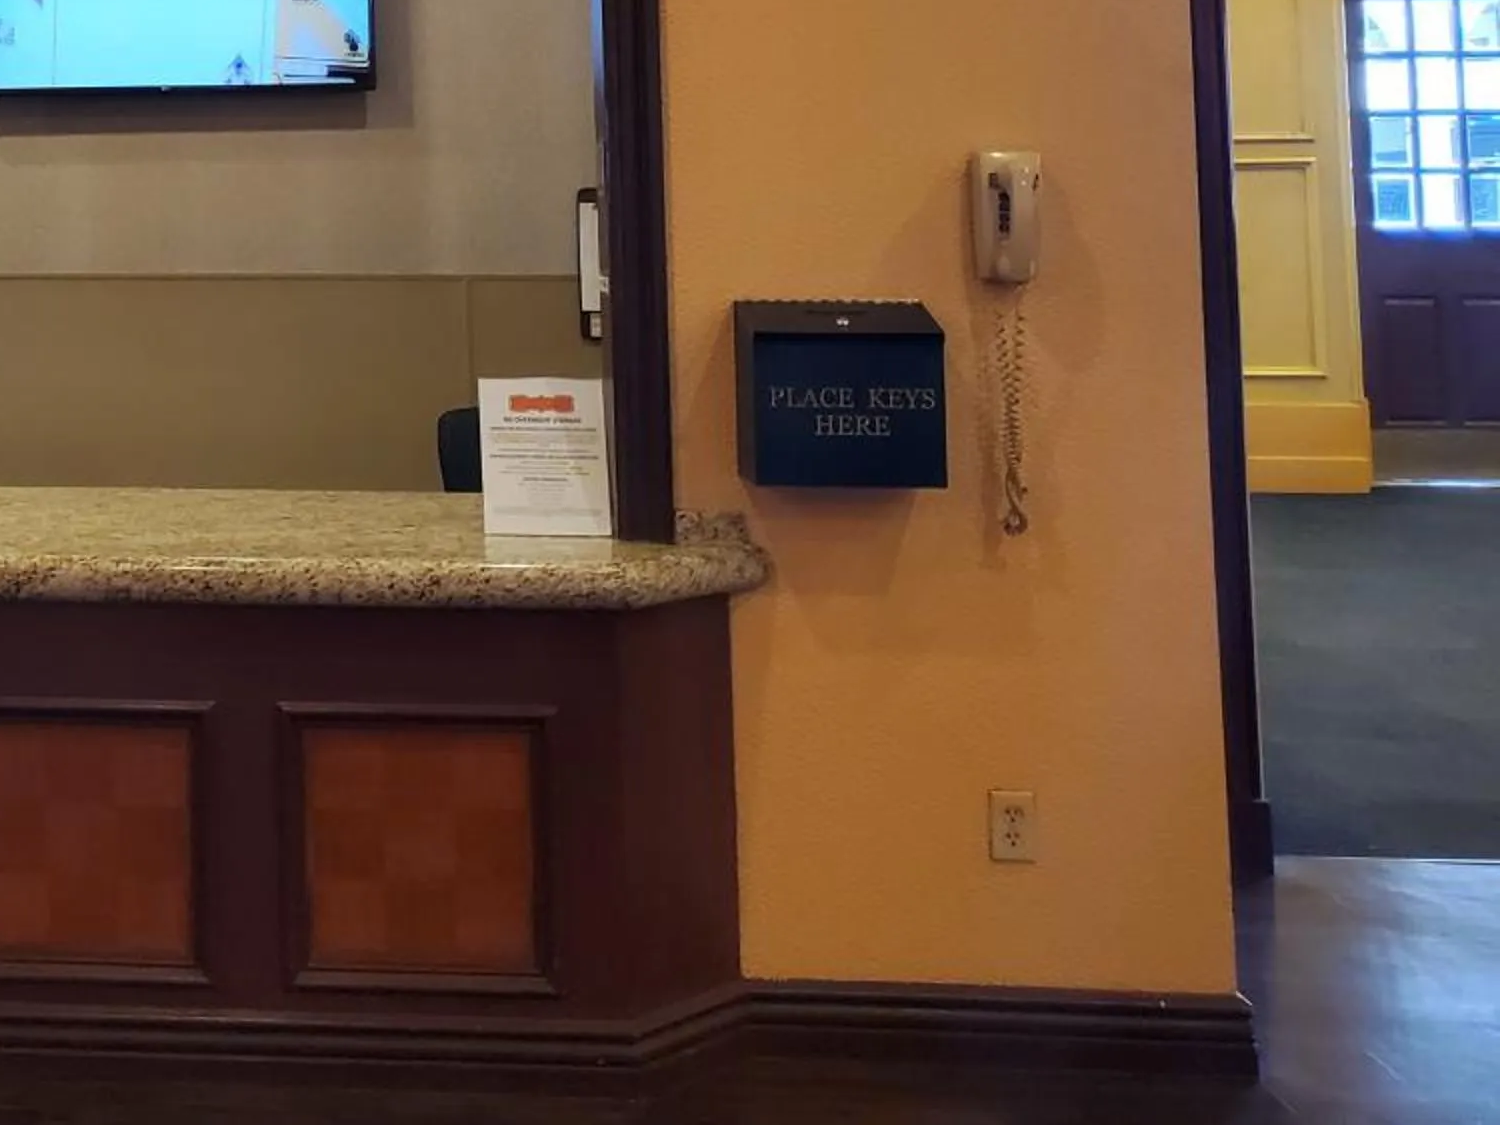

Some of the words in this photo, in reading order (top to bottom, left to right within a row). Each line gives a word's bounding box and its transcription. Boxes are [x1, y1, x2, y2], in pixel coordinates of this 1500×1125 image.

[768, 386, 856, 410] PLACE
[868, 387, 937, 410] KEYS
[814, 414, 892, 437] HERE
